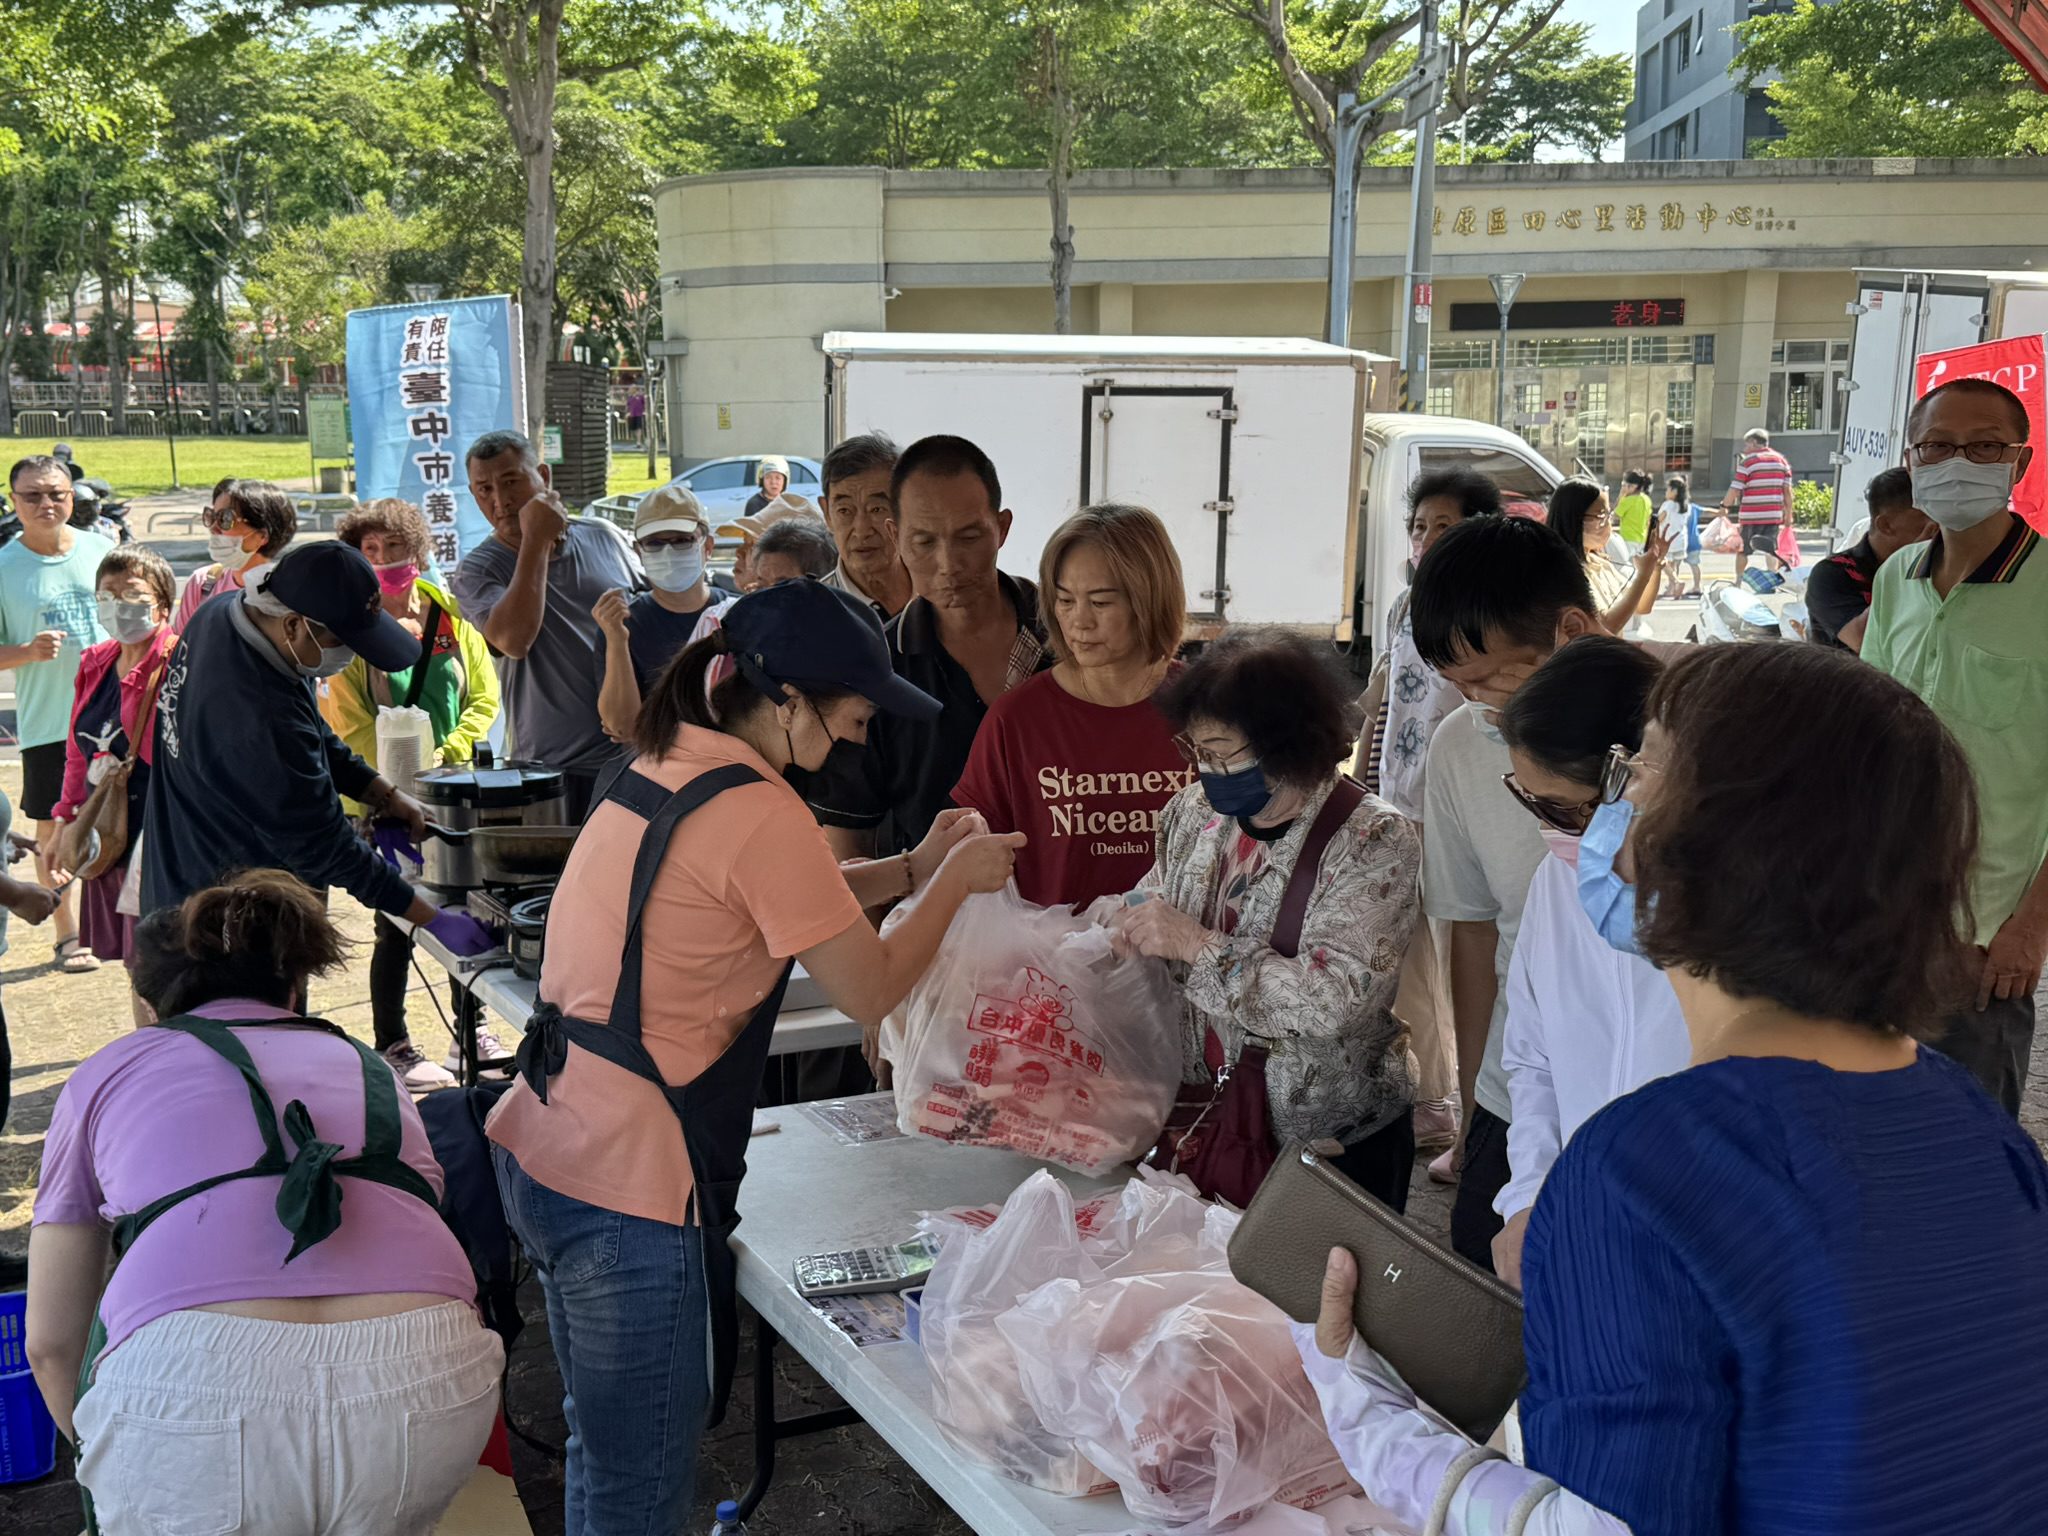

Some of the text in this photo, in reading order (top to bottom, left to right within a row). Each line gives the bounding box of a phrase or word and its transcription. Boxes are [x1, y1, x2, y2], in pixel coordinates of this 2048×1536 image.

[402, 372, 457, 585] 臺中市養豬
[1038, 763, 1196, 800] Starnext
[1090, 840, 1150, 857] (Deoika)
